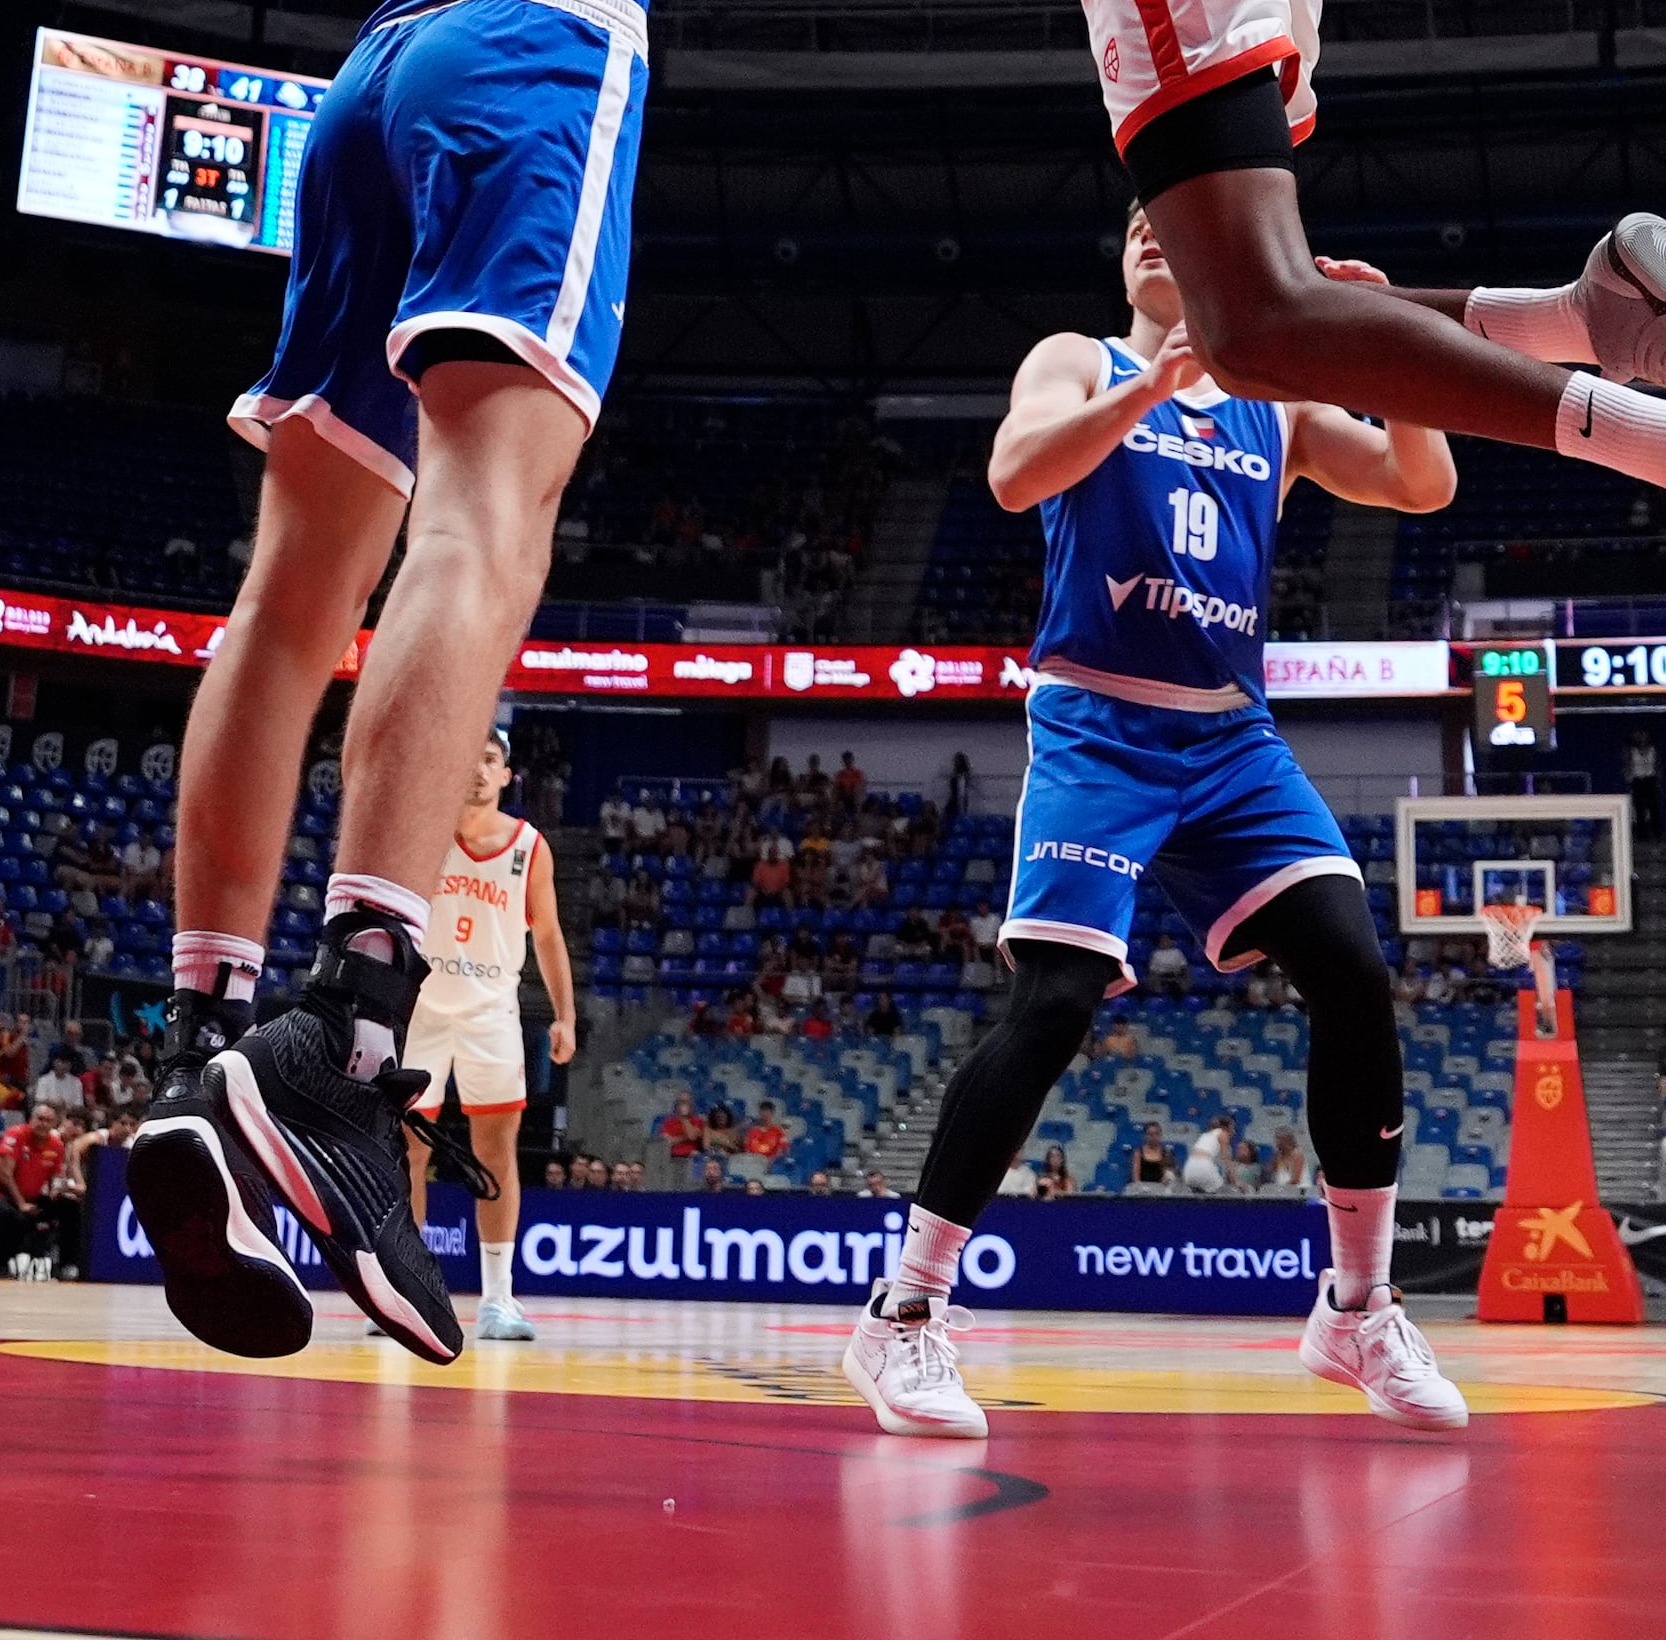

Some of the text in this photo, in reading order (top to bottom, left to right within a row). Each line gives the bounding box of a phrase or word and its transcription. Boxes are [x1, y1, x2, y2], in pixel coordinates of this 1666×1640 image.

[1122, 422, 1271, 482] ČESKO
[1168, 487, 1219, 562] 19
[1144, 577, 1259, 638] Tipsport
[1266, 654, 1395, 683] ESPAÑA B
[1481, 650, 1540, 678] 9:10
[1495, 681, 1527, 723] 5
[454, 916, 473, 943] 9
[522, 1206, 1317, 1291] azulmario new travel
